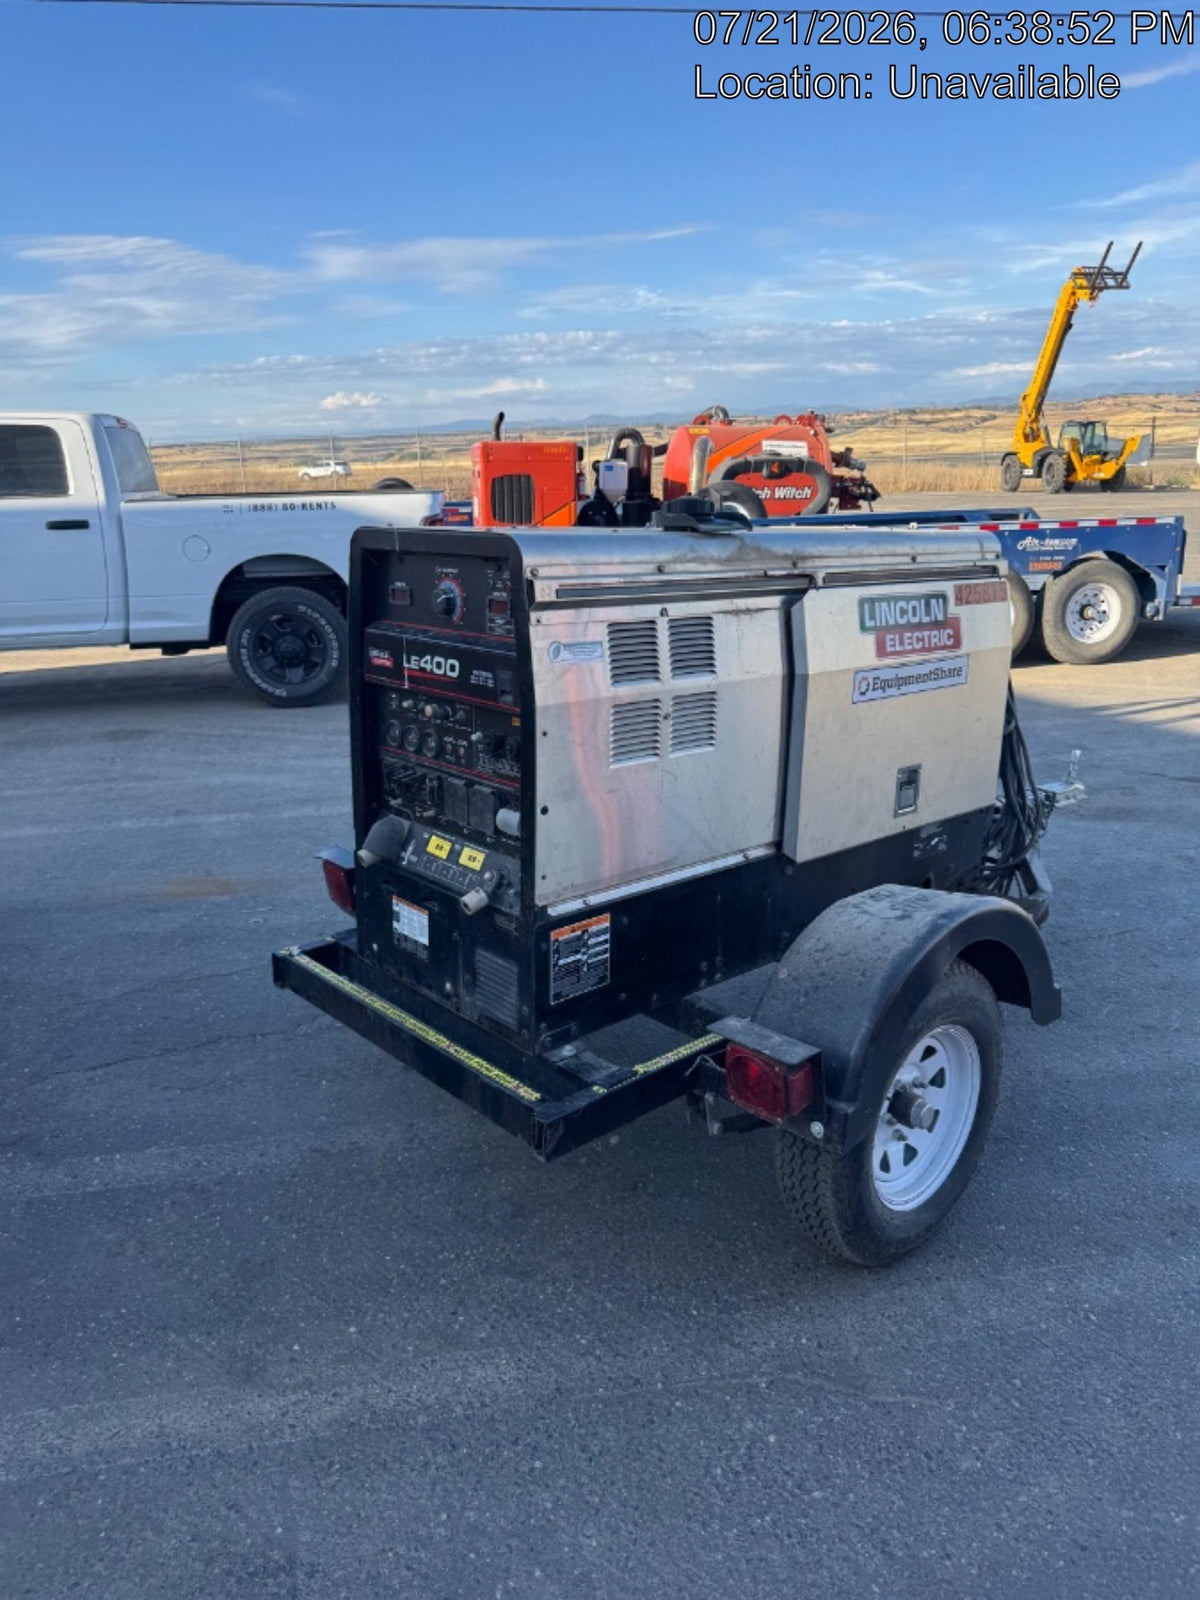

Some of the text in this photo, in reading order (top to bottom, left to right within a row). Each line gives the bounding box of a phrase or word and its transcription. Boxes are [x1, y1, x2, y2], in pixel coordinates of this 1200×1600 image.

[774, 486, 812, 499] Witch
[863, 598, 944, 627] LINCOLN
[885, 628, 954, 652] ELECTRIC
[403, 653, 460, 678] LE400
[871, 665, 963, 693] EquipmentShare
